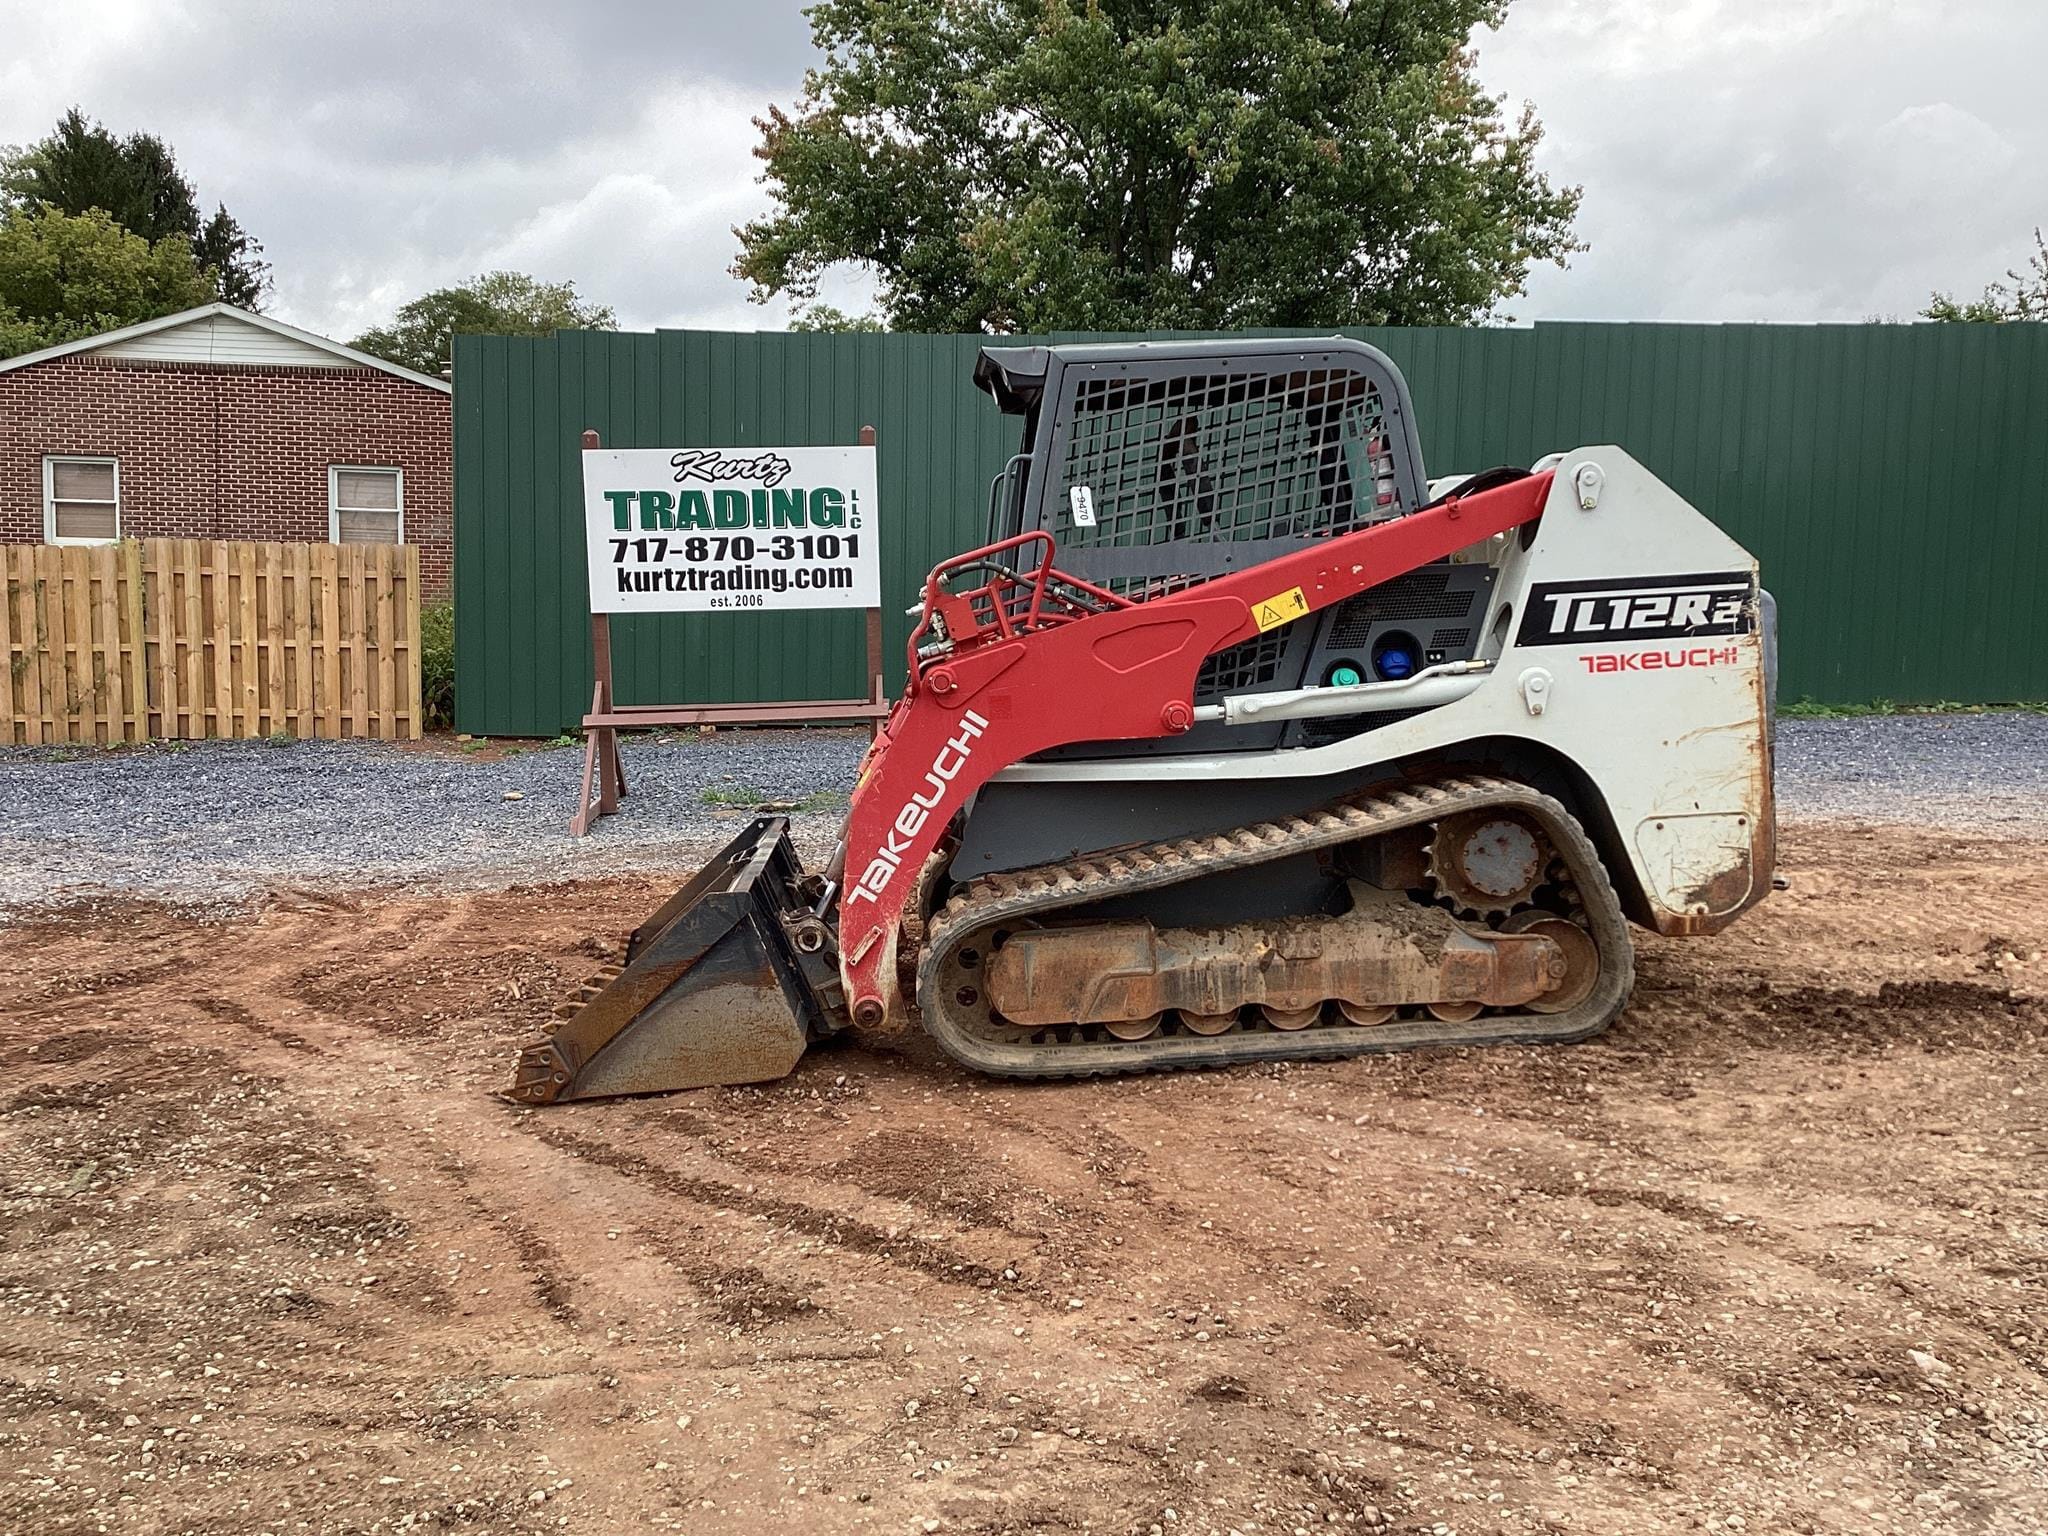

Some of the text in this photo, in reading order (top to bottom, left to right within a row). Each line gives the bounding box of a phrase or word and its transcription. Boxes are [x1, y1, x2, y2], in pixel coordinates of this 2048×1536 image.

[670, 450, 791, 487] Kurtz
[603, 487, 846, 531] TRADING
[1077, 497, 1089, 520] 9470
[608, 534, 859, 563] 717-870-3101
[617, 564, 853, 593] kurtztrading.com
[710, 594, 763, 607] est. 2006
